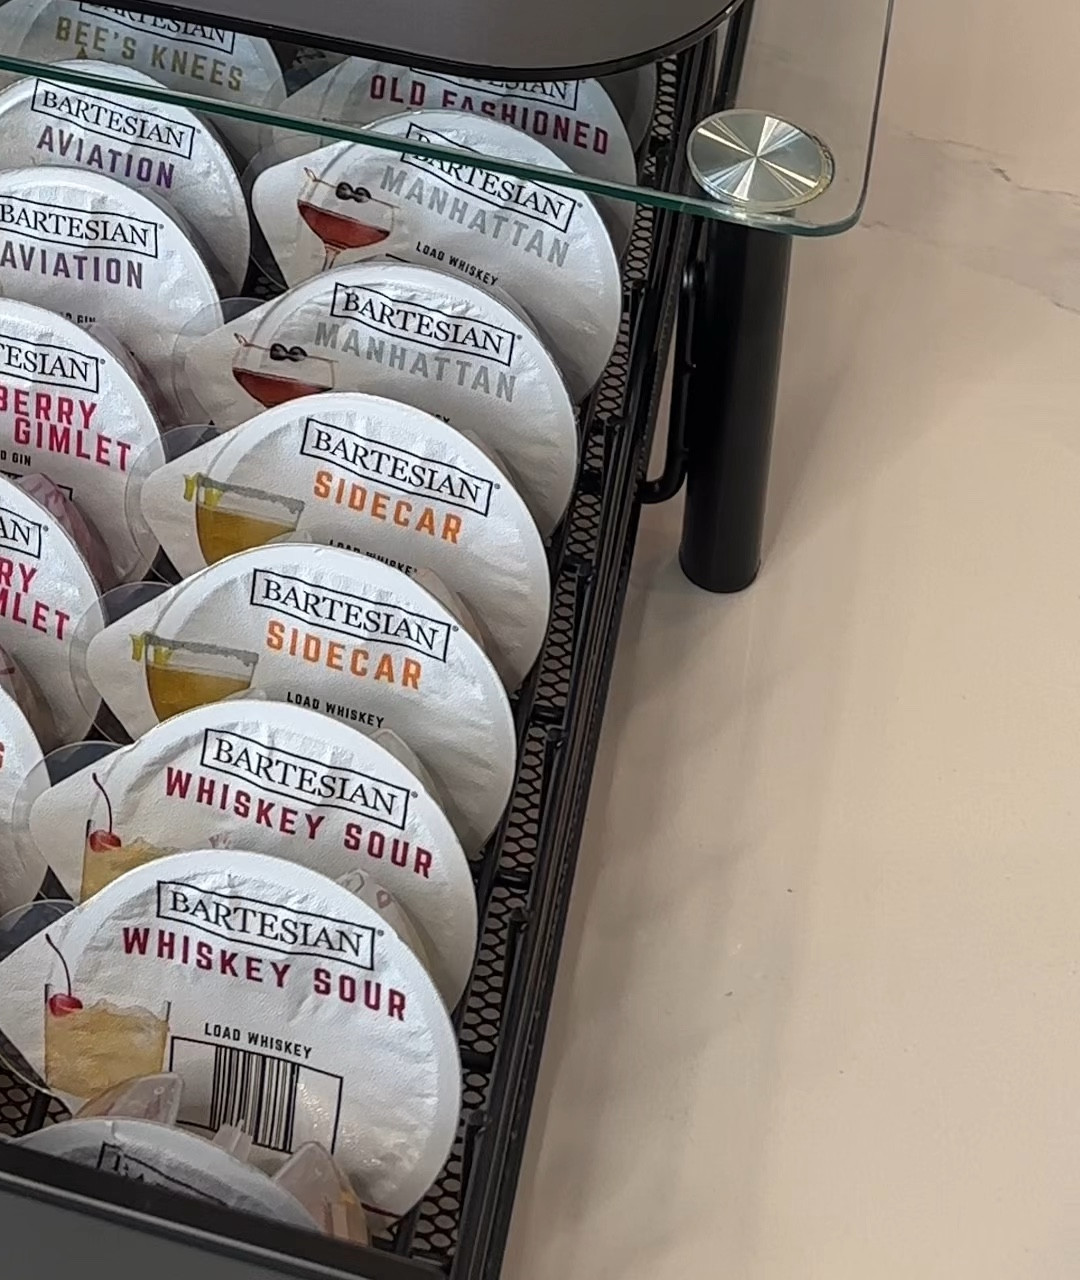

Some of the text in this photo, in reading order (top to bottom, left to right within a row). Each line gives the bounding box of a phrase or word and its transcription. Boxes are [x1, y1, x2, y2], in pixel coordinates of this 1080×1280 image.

[55, 16, 244, 92] BEE'S KNEES
[41, 89, 185, 150] BARTESIAN
[370, 74, 426, 107] OLD
[36, 125, 176, 189] AVIATION
[0, 203, 149, 248] BARTESIAN
[379, 165, 570, 268] MANHATTAN
[0, 240, 144, 290] AVIATION
[416, 240, 499, 287] LOAD WHISKEY
[342, 291, 505, 355] BARTESIAN
[315, 321, 518, 404] MANHATTAN
[11, 452, 32, 468] GIN
[14, 417, 132, 472] GIMLET
[311, 428, 483, 504] BARTESIAN
[313, 469, 465, 545] SIDECAR
[262, 578, 441, 651] BARTESIAN
[266, 619, 424, 691] SIDECAR
[286, 691, 385, 729] LOAD WHISKEY
[212, 737, 398, 816] BARTESIAN
[166, 766, 434, 880] WHISKEY SOUR
[170, 890, 363, 958] BARTESIAN
[123, 926, 407, 1022] WHISKEY SOUR
[204, 1022, 313, 1060] LOAD WHISKEY
